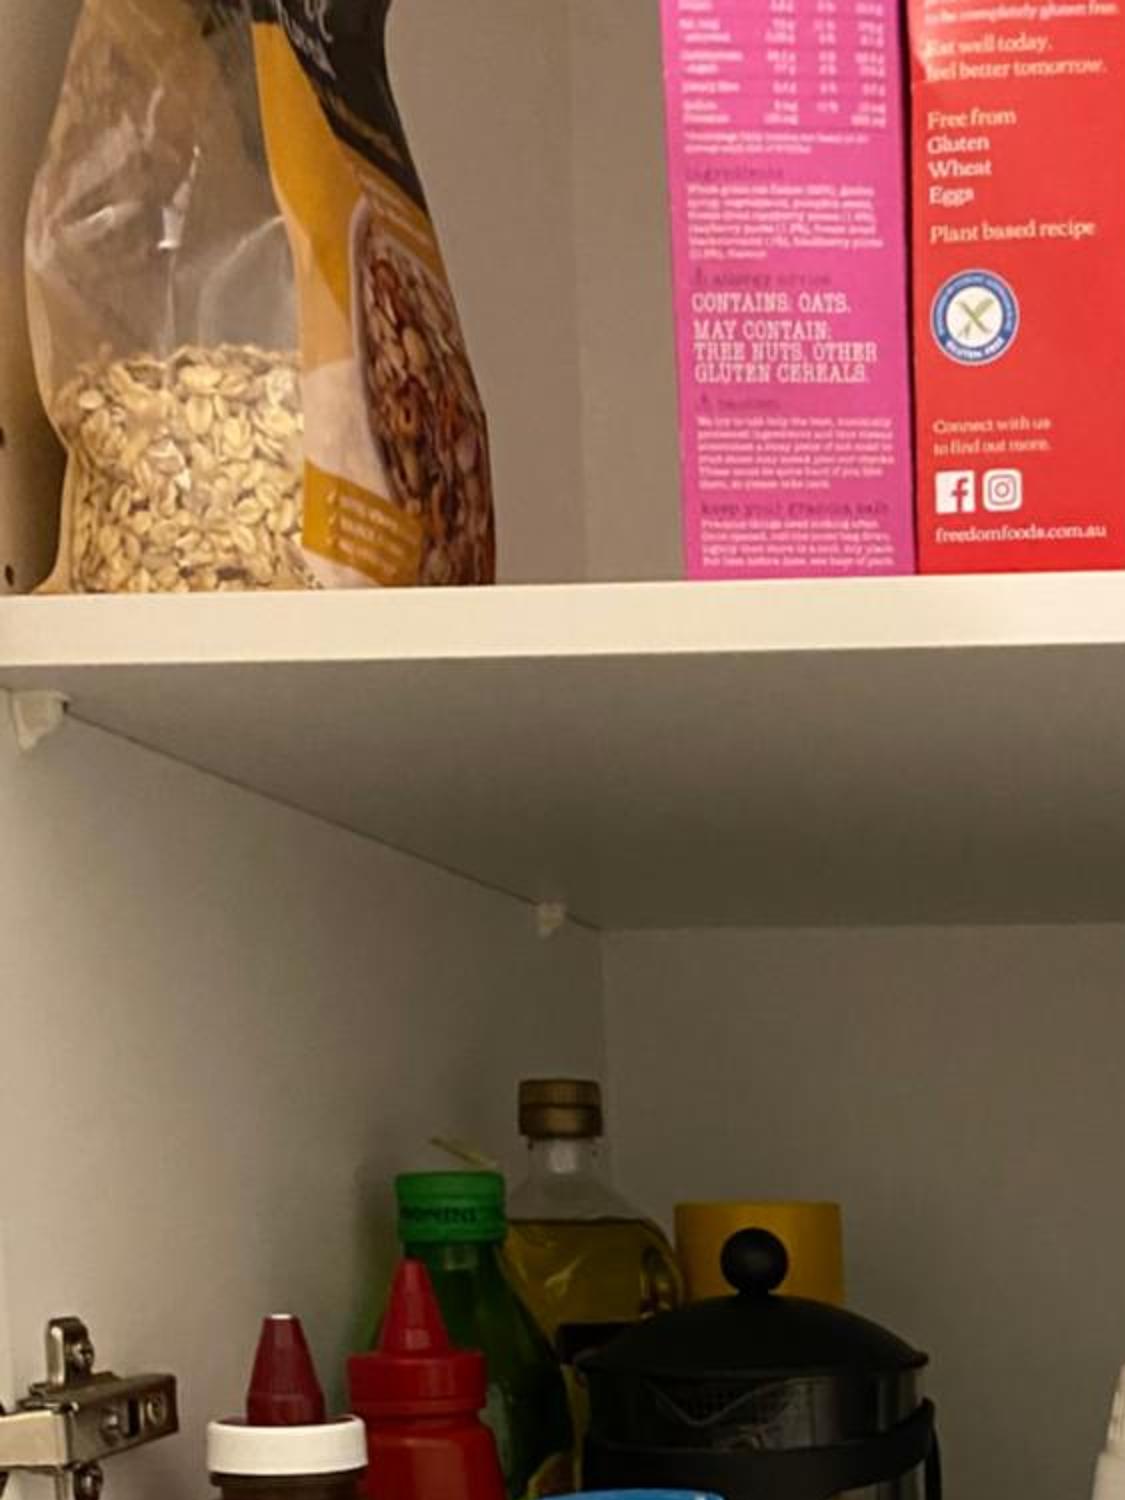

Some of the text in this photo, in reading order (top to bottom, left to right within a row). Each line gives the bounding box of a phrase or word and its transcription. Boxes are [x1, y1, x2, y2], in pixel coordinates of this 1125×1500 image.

[958, 33, 995, 53] well
[959, 62, 1010, 79] better
[928, 106, 1017, 129] Free from
[928, 135, 990, 155] Gluten
[928, 159, 992, 178] Wheat
[929, 186, 974, 207] Eggs
[930, 218, 1096, 243] Plant based recipe
[693, 320, 737, 341] MAY
[694, 342, 746, 362] TREE
[812, 341, 877, 362] OTHER
[694, 363, 770, 384] GLUTEN
[933, 416, 1052, 434] Connect with us
[950, 438, 980, 455] find
[982, 439, 1006, 452] out
[935, 522, 1107, 544] freedomfoods.com.au
